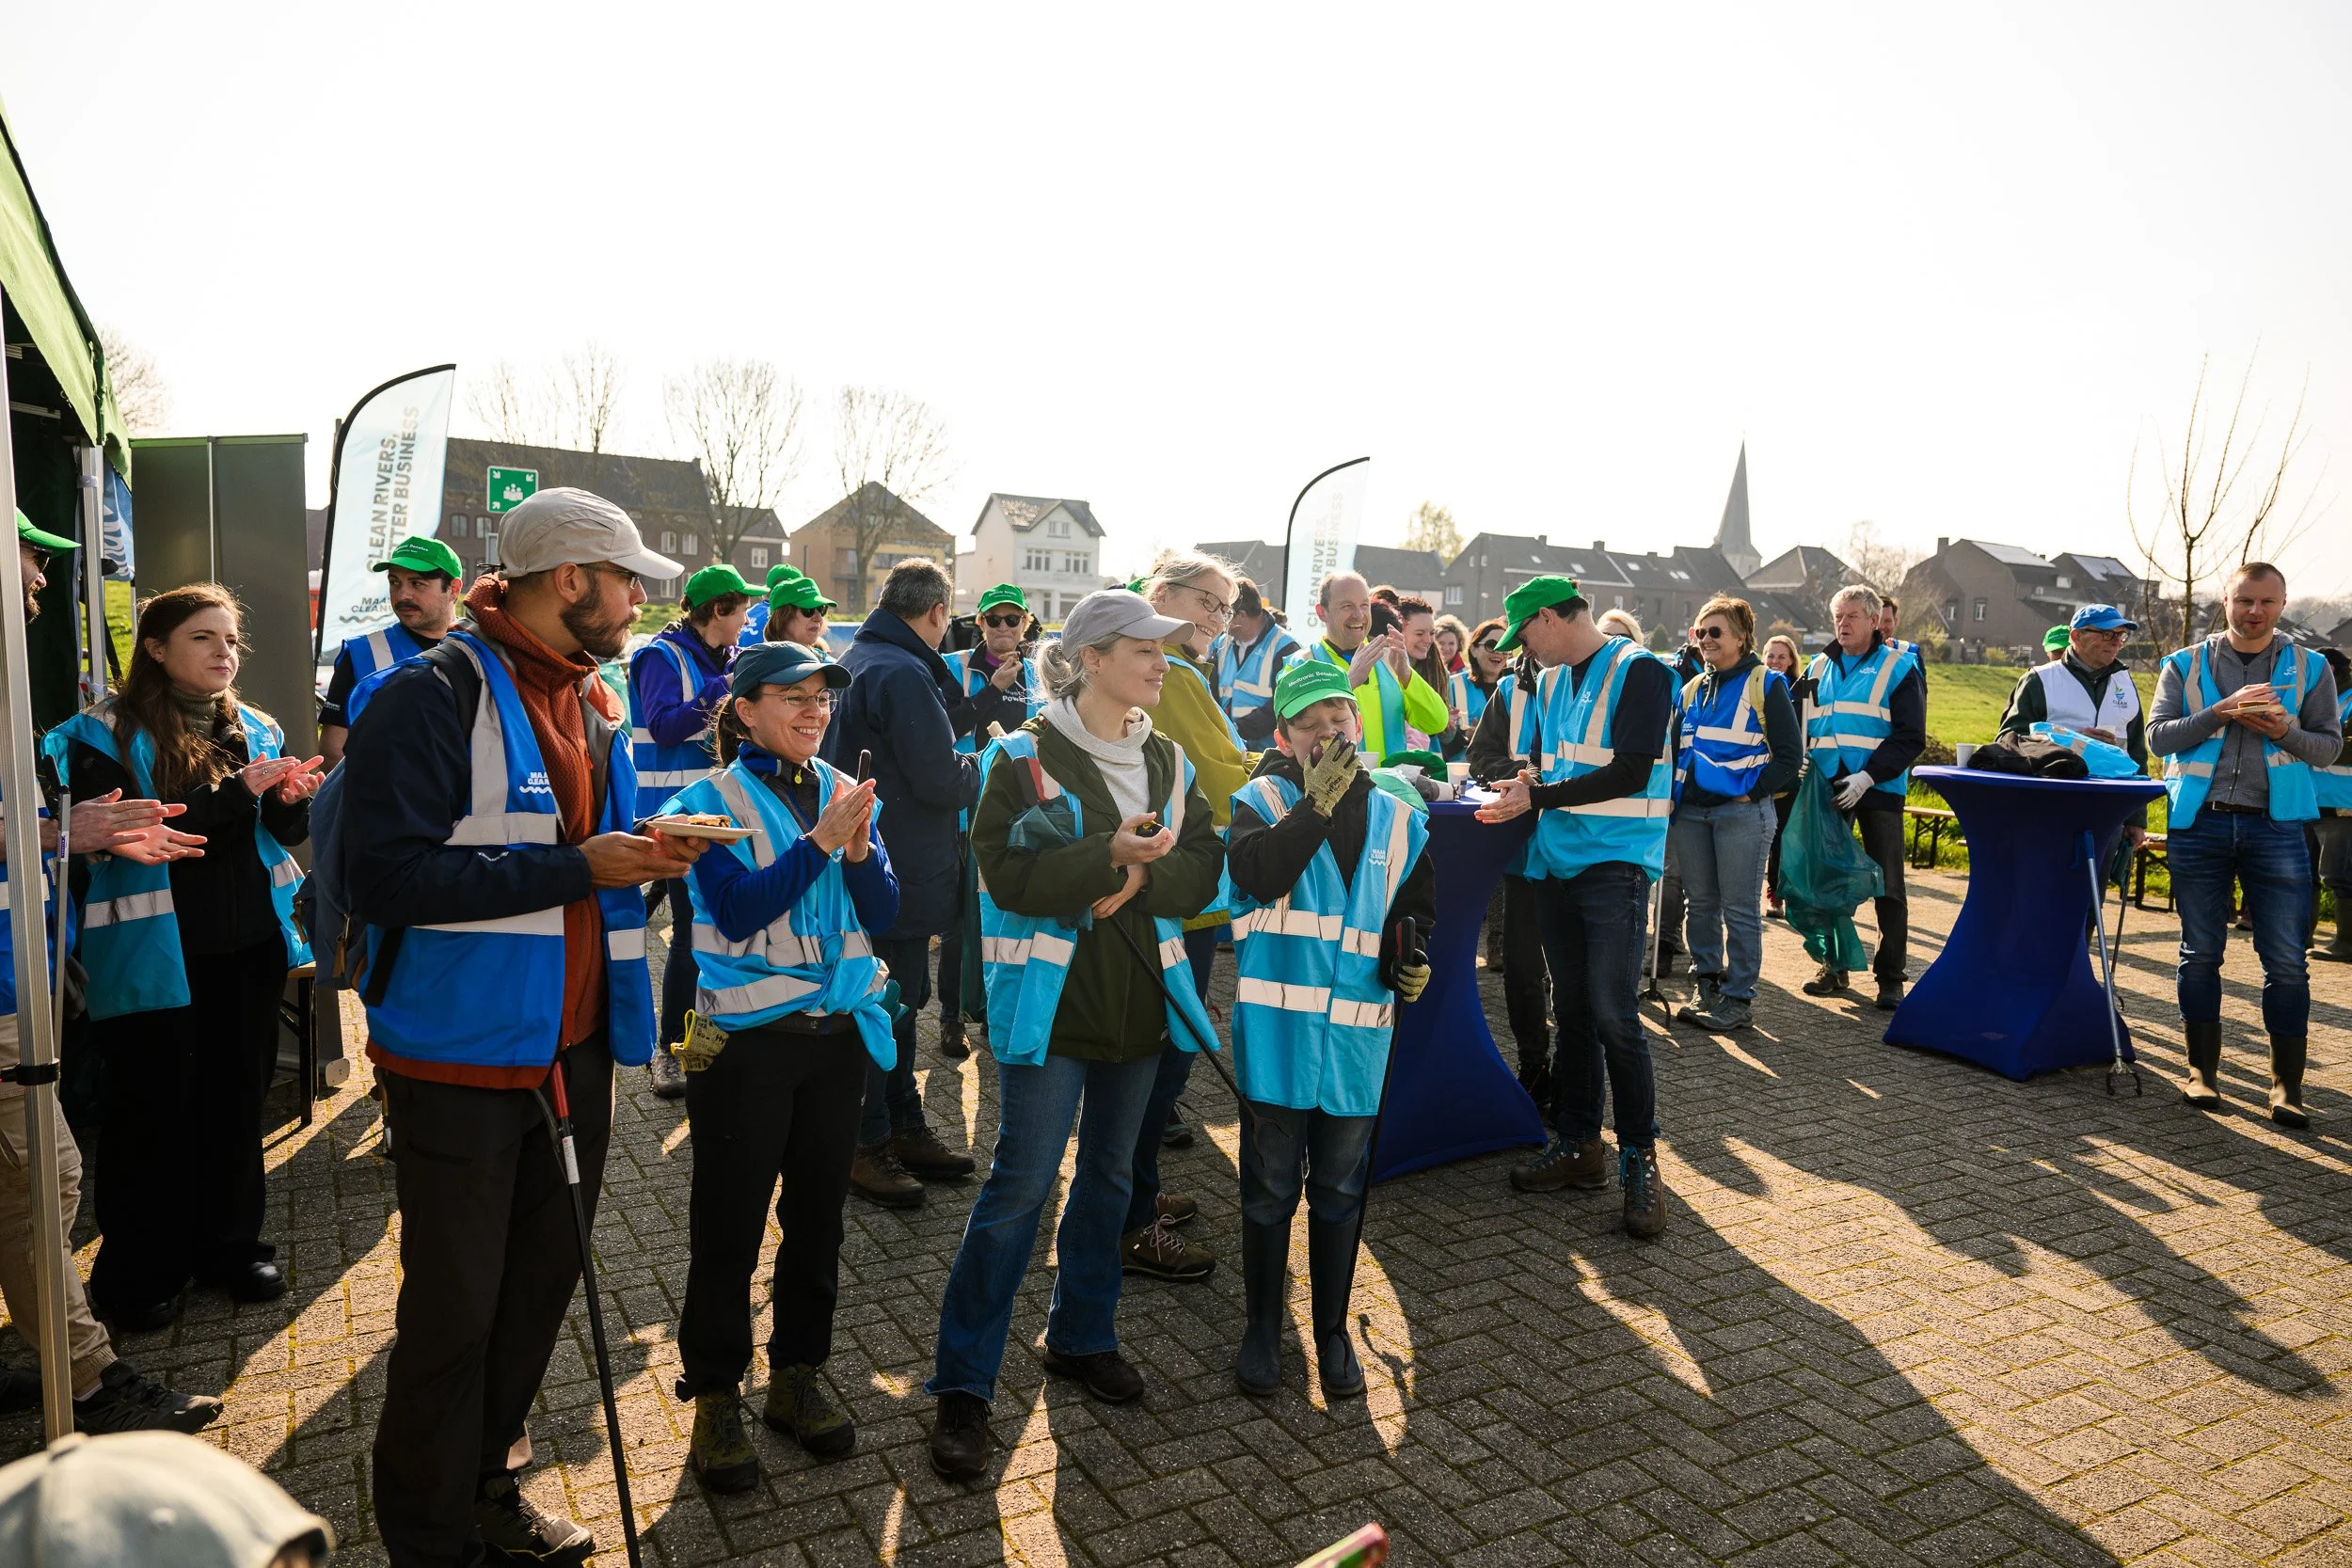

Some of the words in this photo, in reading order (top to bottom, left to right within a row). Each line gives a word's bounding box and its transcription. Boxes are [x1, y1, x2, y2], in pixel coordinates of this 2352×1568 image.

[373, 433, 400, 510] RIVERS,
[392, 405, 420, 499] BUSINESS
[366, 510, 388, 573] CLEAN
[1288, 673, 1315, 688] Medtronic
